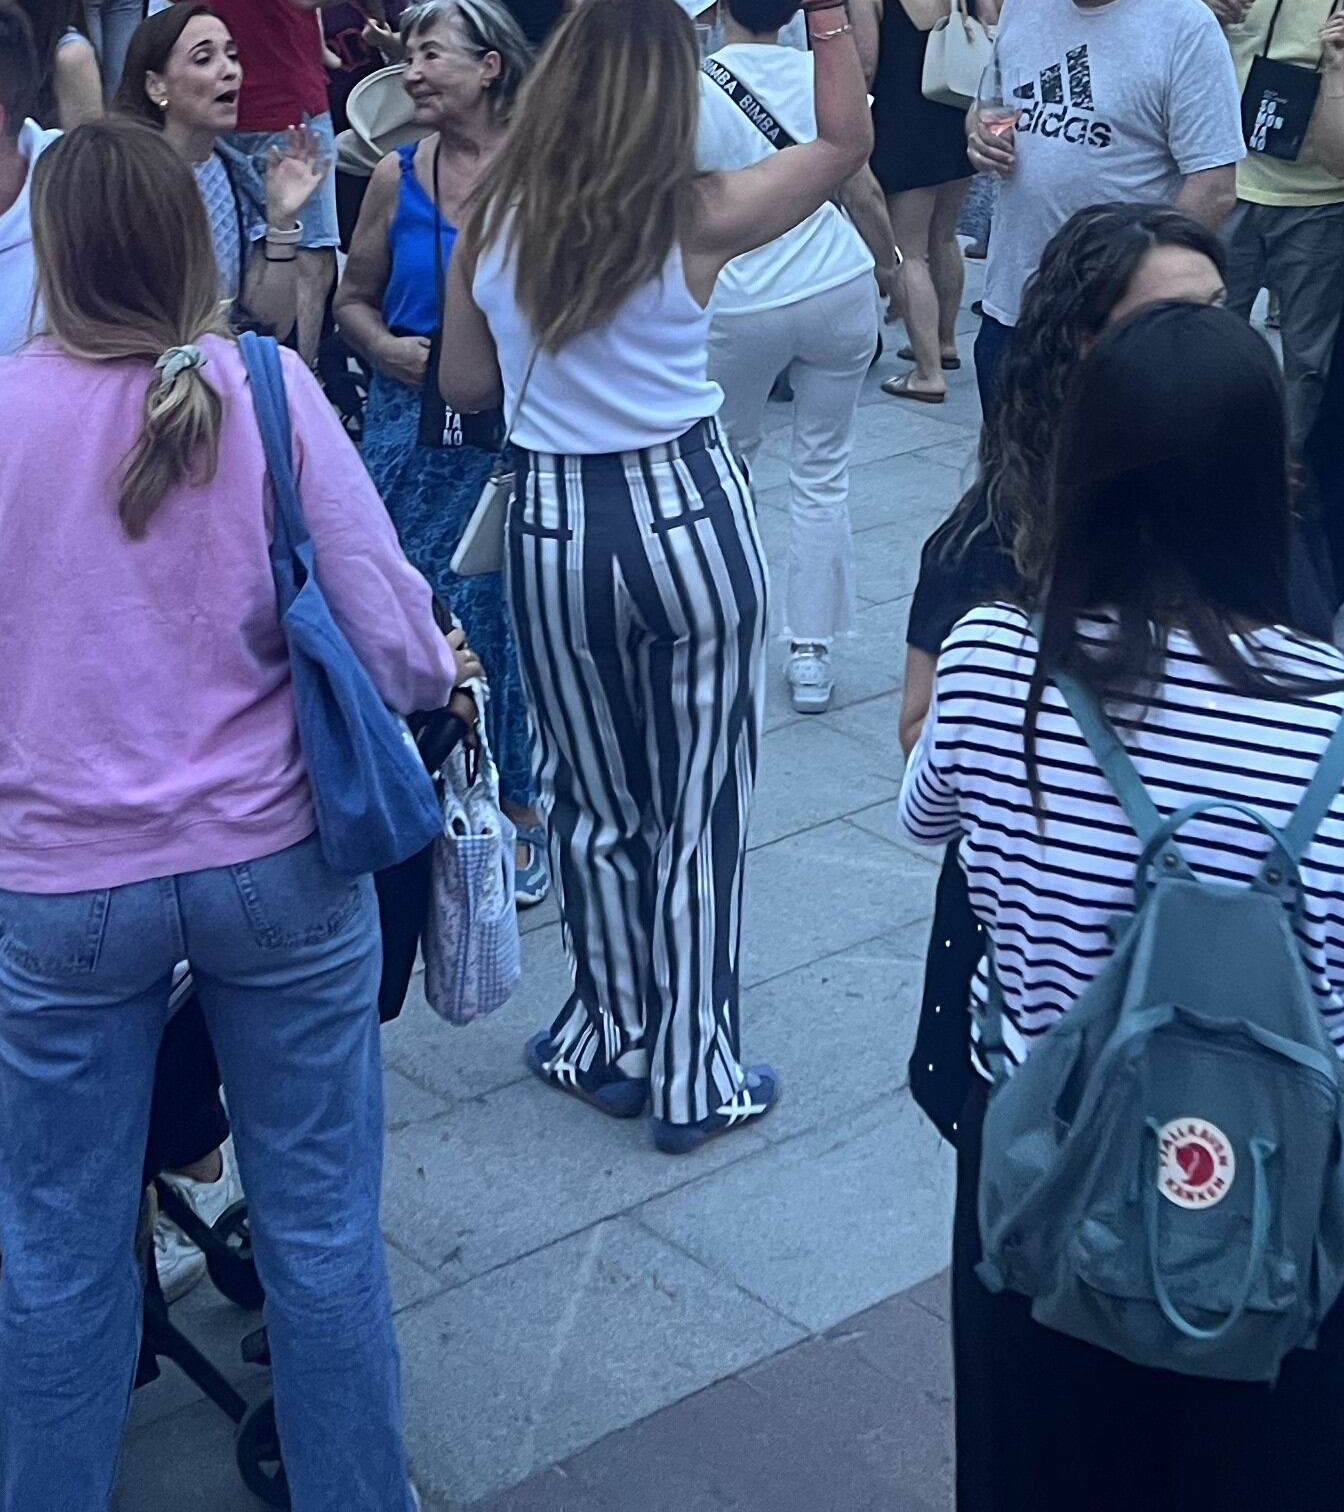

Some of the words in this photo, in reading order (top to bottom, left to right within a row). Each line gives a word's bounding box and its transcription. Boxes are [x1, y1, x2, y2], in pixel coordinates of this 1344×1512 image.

[738, 93, 781, 142] BIMBA
[1013, 100, 1112, 149] didas
[442, 428, 463, 446] NO
[445, 411, 462, 430] TA
